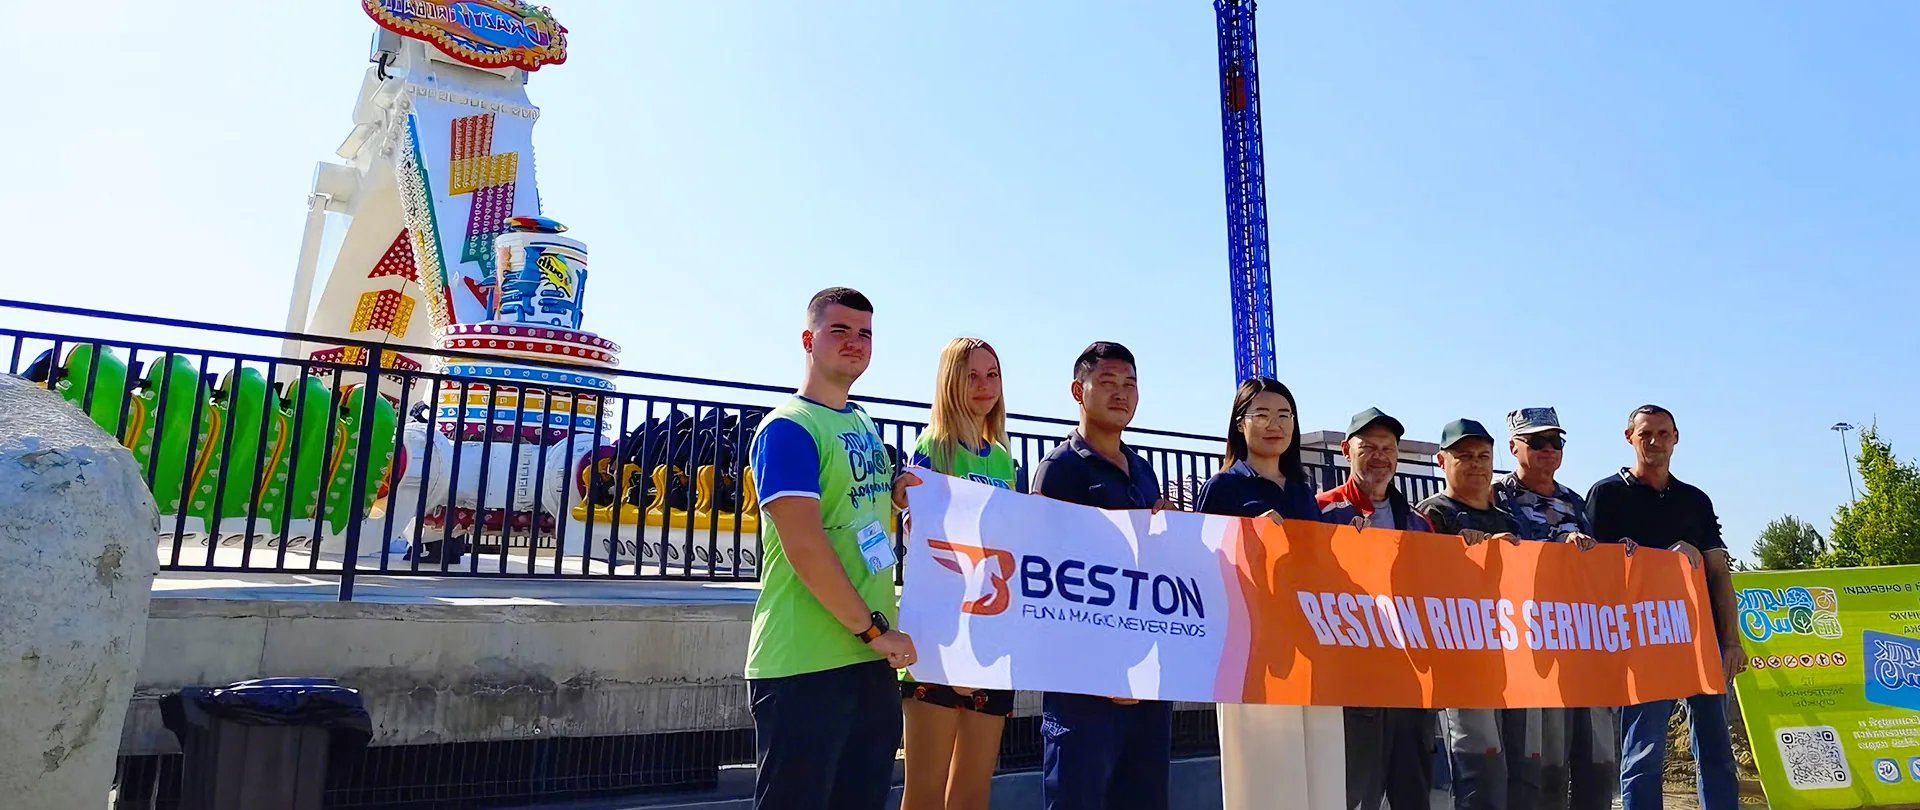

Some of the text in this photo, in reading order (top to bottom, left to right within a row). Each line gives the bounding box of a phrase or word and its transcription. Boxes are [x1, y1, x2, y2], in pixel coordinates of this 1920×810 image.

[1021, 555, 1205, 619] BESTON
[1022, 604, 1055, 620] FUN
[1117, 616, 1167, 634] NEVER
[1170, 621, 1206, 637] ENDS
[1297, 591, 1693, 653] BESTON RIDES SERVICE TEAM
